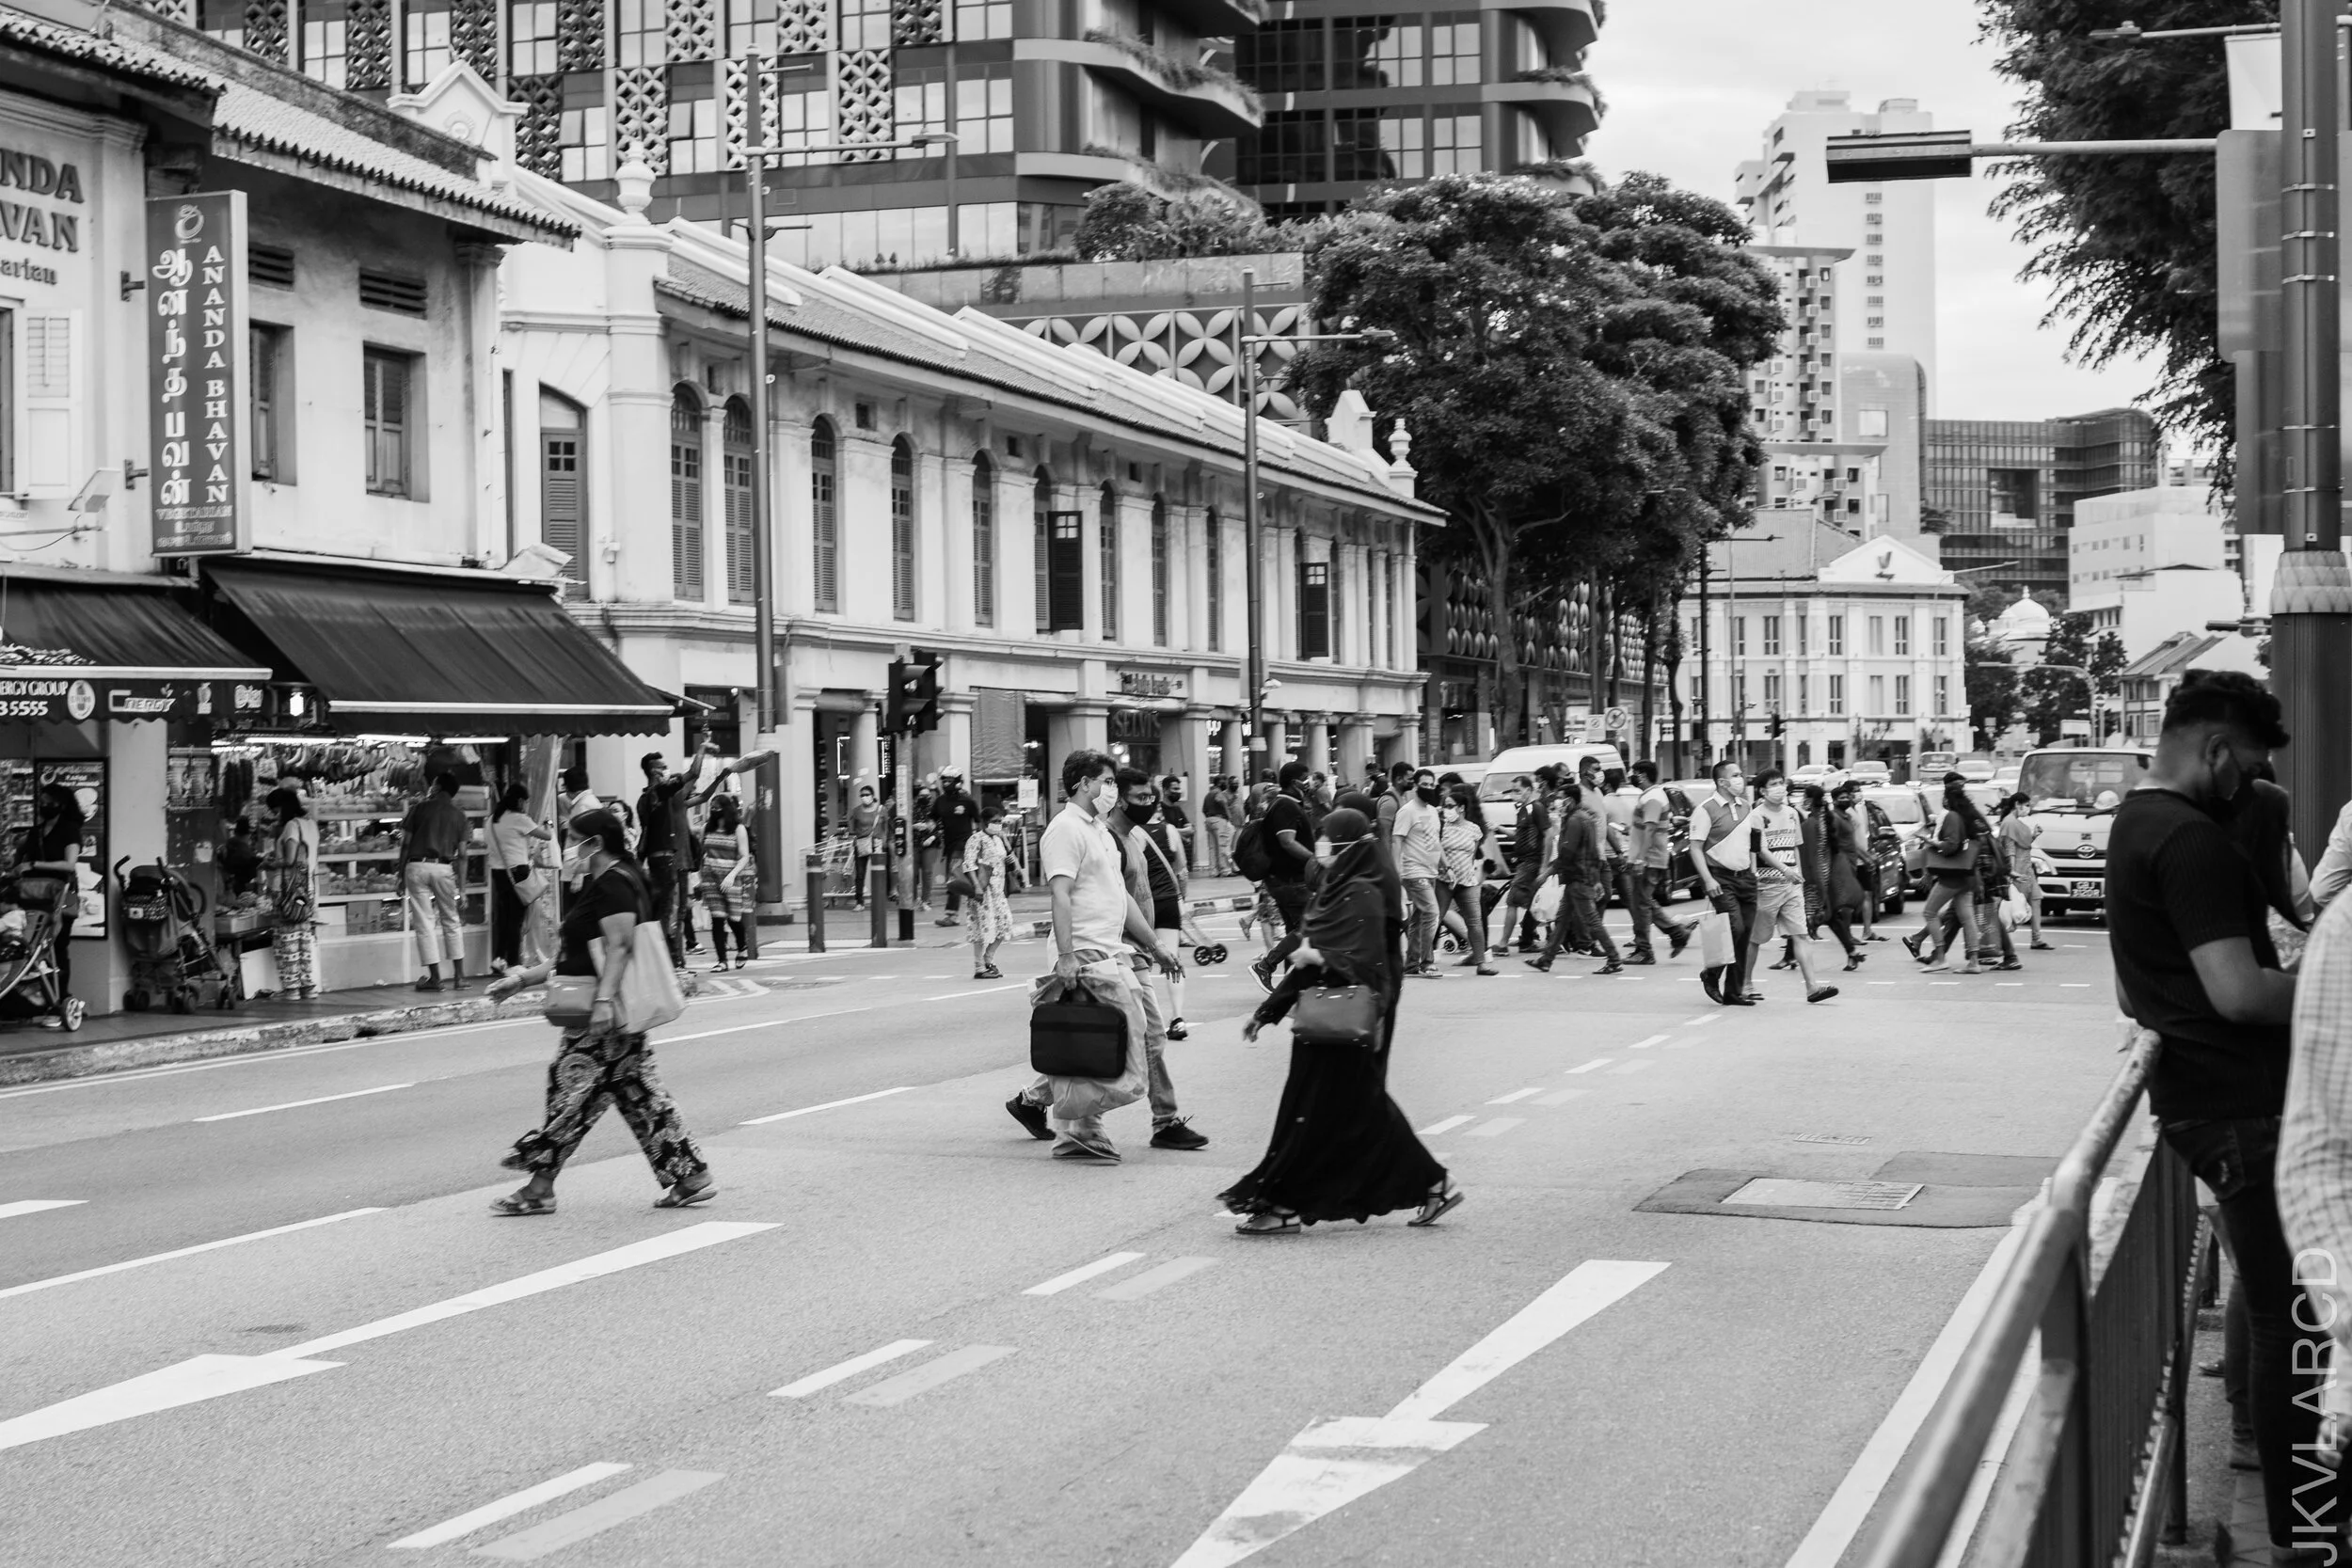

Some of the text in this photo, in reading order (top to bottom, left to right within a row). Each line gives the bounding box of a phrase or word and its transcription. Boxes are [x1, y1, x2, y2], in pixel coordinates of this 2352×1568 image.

[201, 245, 230, 503] ANANDA BHAVAN
[28, 680, 69, 696] GROUP
